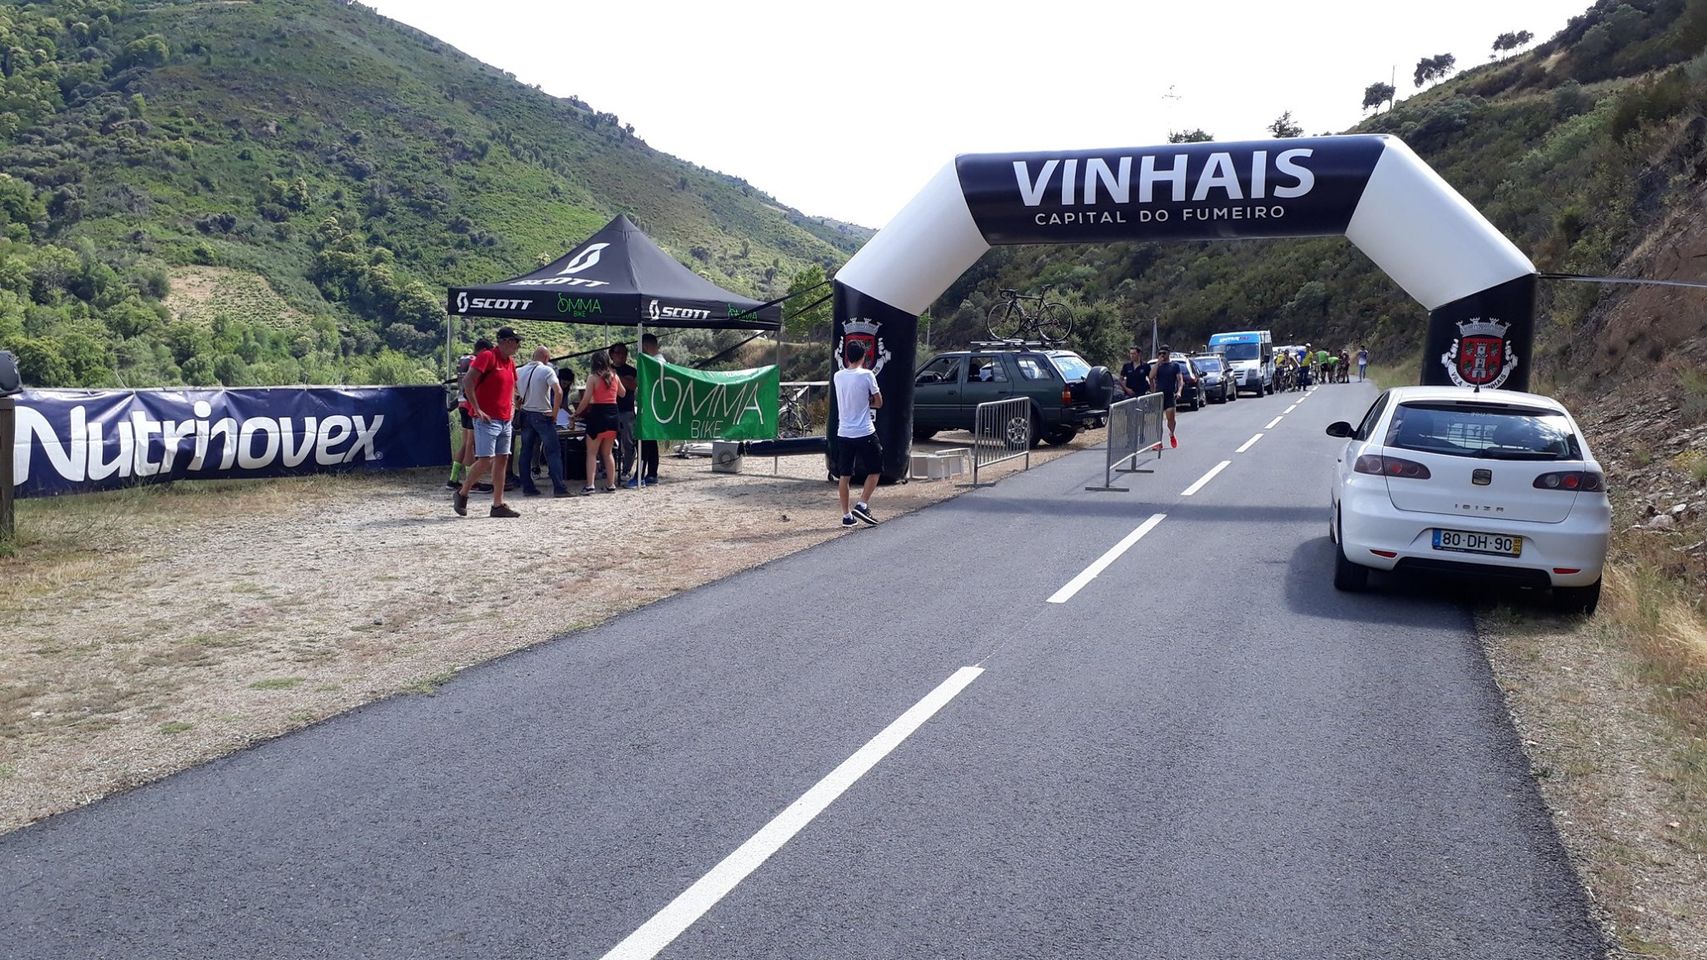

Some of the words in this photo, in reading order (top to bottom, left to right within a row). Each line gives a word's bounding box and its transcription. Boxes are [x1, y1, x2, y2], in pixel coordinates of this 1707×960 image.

[1013, 148, 1315, 206] VINHAIS
[1035, 211, 1126, 225] CAPITAL
[1140, 210, 1169, 222] DO
[1183, 206, 1285, 221] FUMEIRO
[509, 277, 610, 287] SCOTT
[470, 298, 533, 310] SCOTT
[557, 293, 602, 313] OMMA
[661, 306, 711, 319] SCOTT
[651, 362, 764, 425] OMMA
[690, 420, 723, 439] BIKE
[13, 400, 384, 486] Nutrinovex
